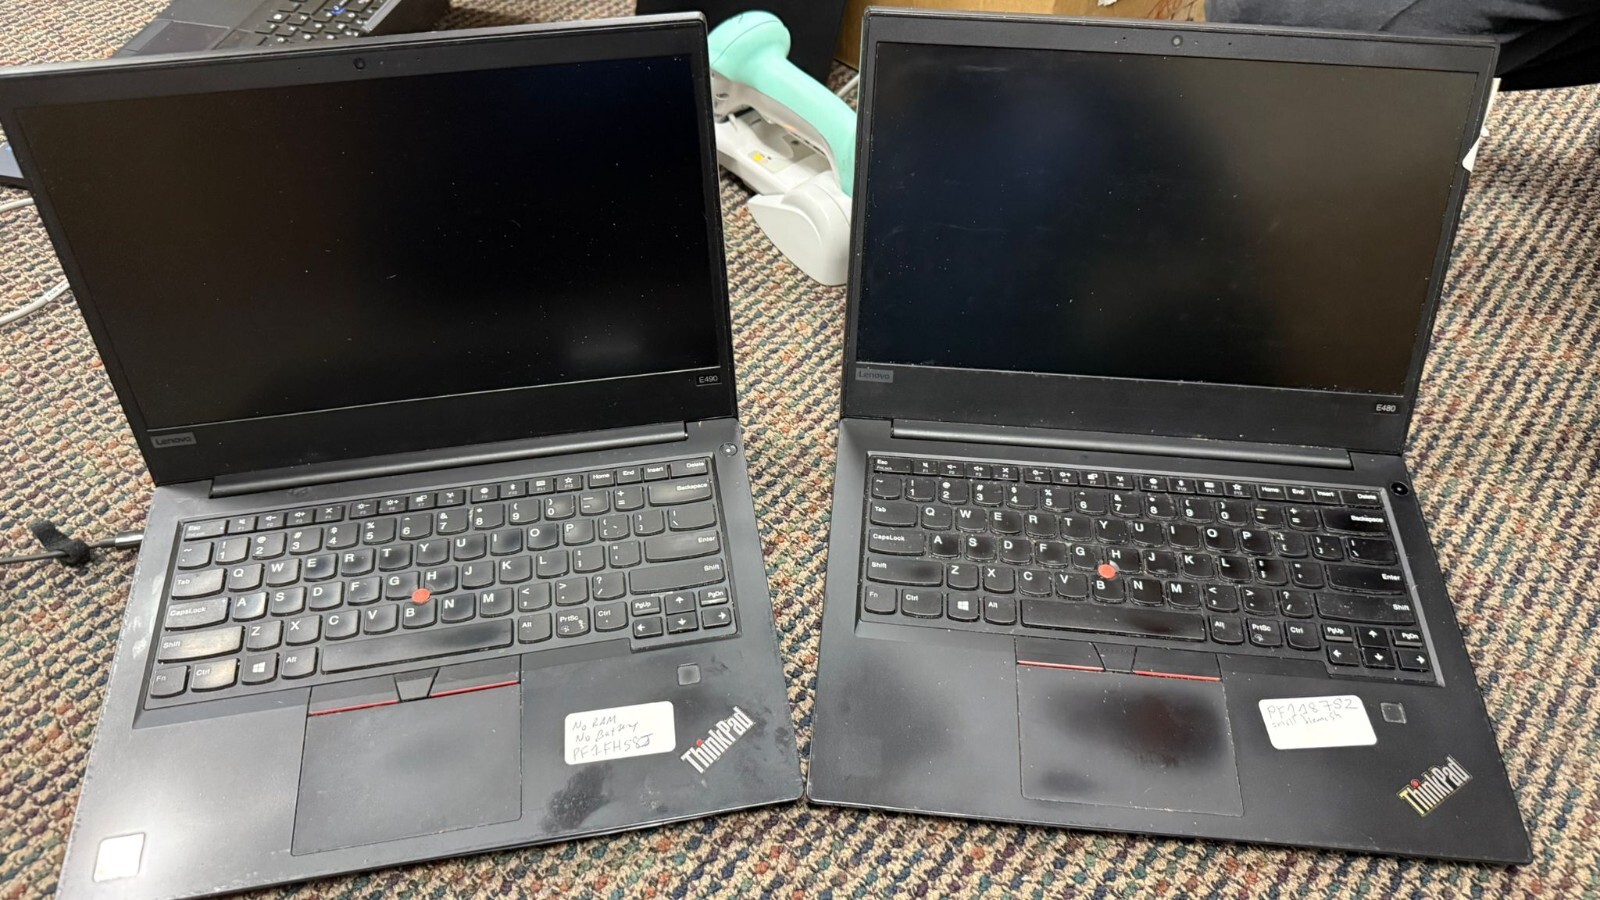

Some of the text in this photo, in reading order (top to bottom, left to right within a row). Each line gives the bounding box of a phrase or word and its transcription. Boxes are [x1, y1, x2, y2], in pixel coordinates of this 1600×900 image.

[858, 370, 890, 380] Lenovo
[1376, 404, 1396, 412] E480
[155, 436, 192, 446] Lenovo
[677, 482, 708, 491] Backspace
[925, 507, 935, 516] Q
[960, 510, 971, 519] W
[1150, 506, 1158, 514] 8
[1186, 508, 1193, 517] 9
[994, 513, 1002, 521] E
[1029, 515, 1038, 524] R
[1064, 518, 1072, 527] T
[1100, 520, 1108, 529] Y
[566, 524, 574, 533] P
[1135, 523, 1144, 532] U
[1170, 526, 1175, 534] I
[530, 529, 540, 537] O
[873, 533, 905, 542] CapsLock
[1207, 529, 1218, 538] O
[1242, 531, 1251, 540] P
[456, 538, 466, 547] U
[934, 535, 942, 544] A
[969, 537, 978, 547] S
[420, 544, 429, 552] Y
[1004, 540, 1013, 549] D
[1040, 543, 1047, 552] F
[382, 548, 392, 558] T
[1076, 546, 1085, 556] G
[1112, 549, 1121, 558] H
[345, 554, 355, 563] R
[539, 556, 547, 564] L
[1148, 553, 1156, 562] J
[1184, 555, 1194, 564] K
[307, 558, 316, 568] E
[502, 561, 511, 569] K
[1221, 558, 1230, 567] L
[271, 563, 284, 572] W
[465, 567, 472, 576] J
[704, 564, 720, 572] Shift
[951, 566, 959, 574] Z
[234, 568, 244, 578] Q
[427, 572, 437, 580] H
[987, 568, 996, 577] X
[1023, 572, 1032, 581] C
[389, 576, 399, 586] G
[1059, 575, 1069, 584] V
[1382, 573, 1400, 582] Enter
[351, 582, 360, 591] F
[1097, 581, 1105, 590] B
[1133, 581, 1143, 590] N
[1171, 584, 1182, 593] M
[275, 592, 284, 601] S
[313, 588, 322, 597] D
[237, 598, 246, 607] A
[483, 594, 494, 602] M
[444, 599, 454, 608] N
[170, 606, 206, 617] CapsLock
[368, 610, 378, 619] V
[406, 608, 415, 617] B
[329, 616, 339, 625] C
[290, 621, 300, 630] X
[1252, 624, 1271, 632] PrtSc
[251, 627, 260, 636] Z
[1327, 627, 1344, 635] PgUp
[1402, 632, 1419, 640] PgDn
[163, 641, 180, 649] Shift
[196, 668, 210, 676] Ctrl
[572, 715, 616, 731] No RAM
[575, 732, 590, 742] No
[680, 706, 754, 774] ThinkPad
[1397, 754, 1472, 816] ThinkPad
